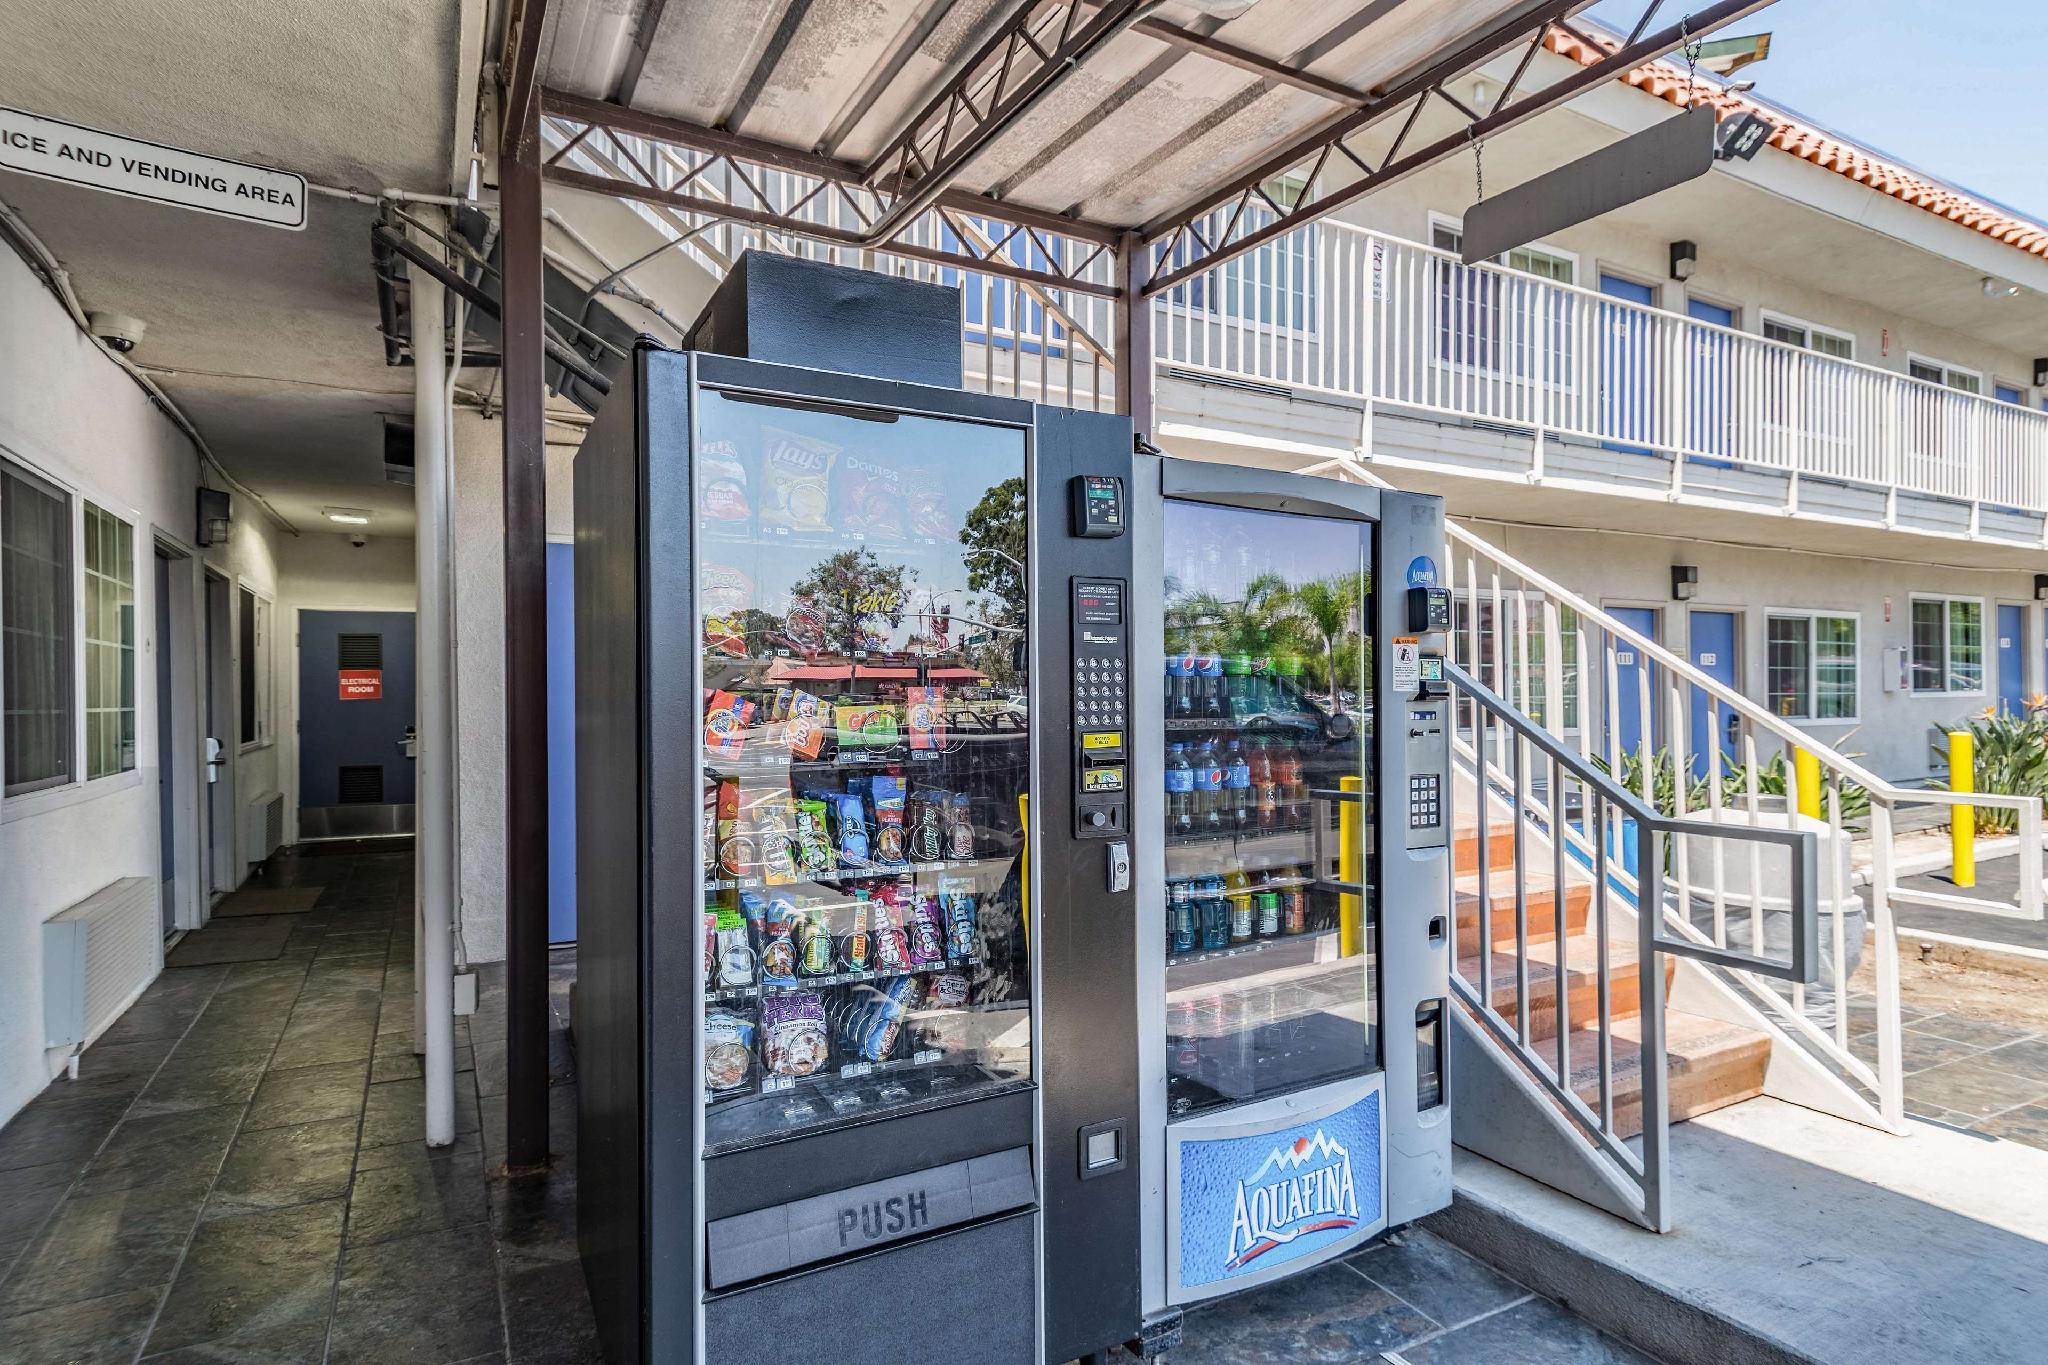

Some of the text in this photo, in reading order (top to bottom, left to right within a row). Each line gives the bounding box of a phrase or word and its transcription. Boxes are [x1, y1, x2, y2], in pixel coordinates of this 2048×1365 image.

[2, 129, 296, 208] ICE AND VENDING AREA
[924, 826, 941, 857] Milky
[765, 1005, 826, 1030] TEXAS
[837, 1188, 928, 1247] PUSH
[1225, 1147, 1359, 1267] AQUAFINA
